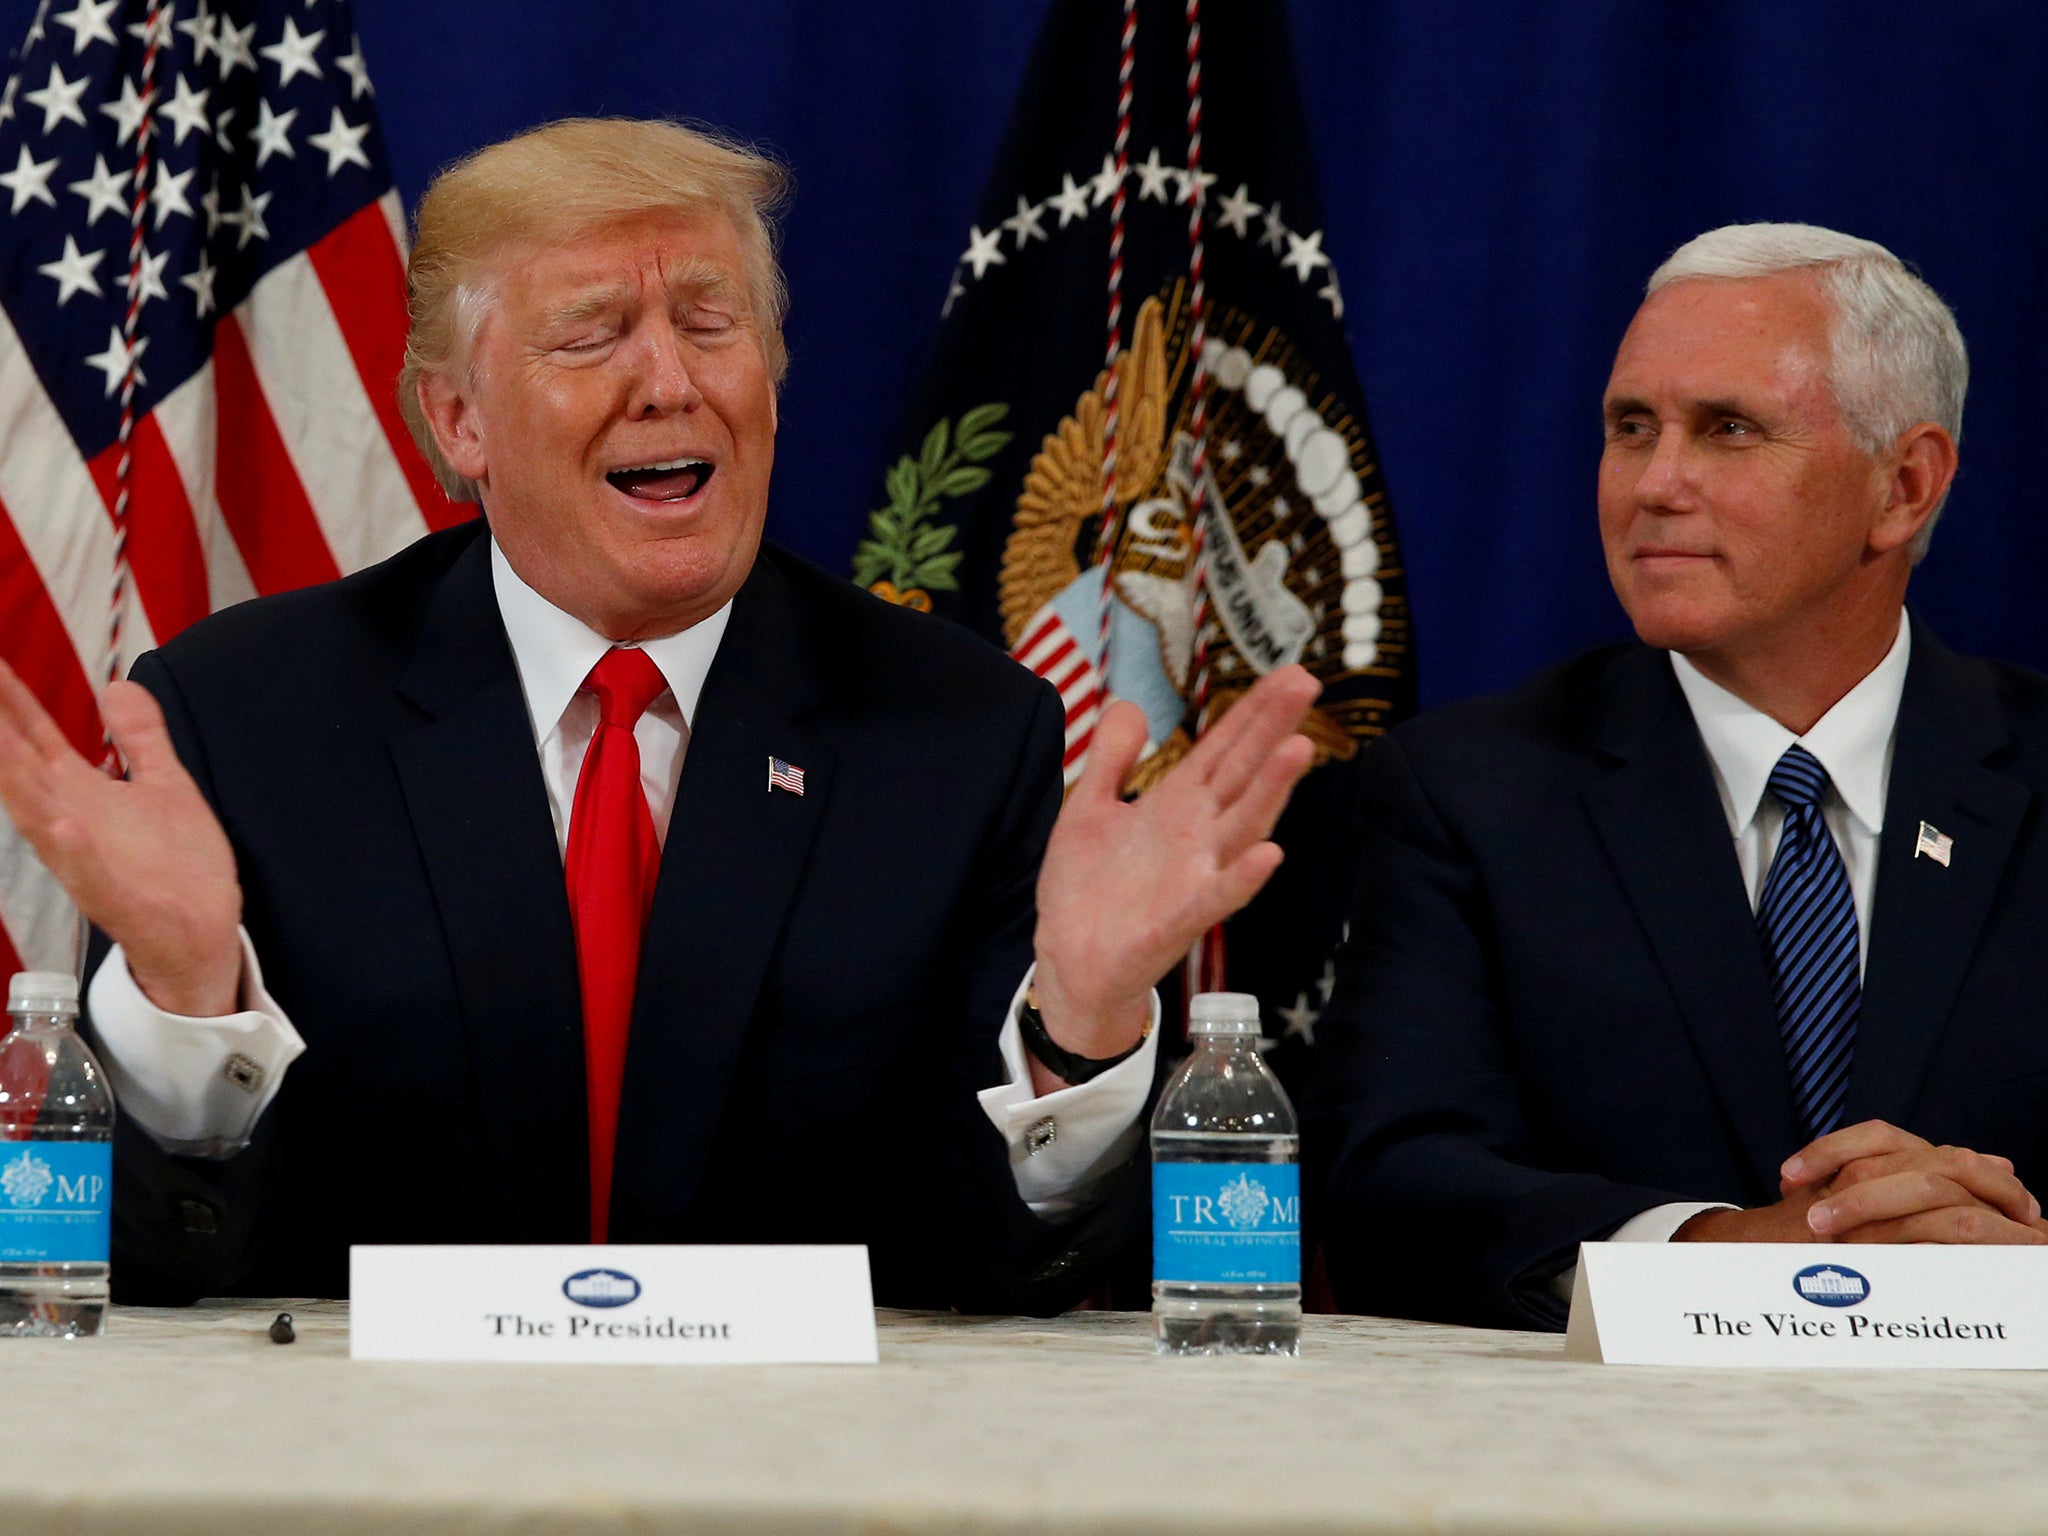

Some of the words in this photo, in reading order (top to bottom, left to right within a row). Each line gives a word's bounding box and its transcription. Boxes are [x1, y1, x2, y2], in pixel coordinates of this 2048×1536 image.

[485, 1314, 554, 1337] The
[568, 1316, 731, 1339] President
[1683, 1312, 1753, 1337] The
[1759, 1313, 1837, 1338] Vice
[1845, 1315, 2008, 1340] President
